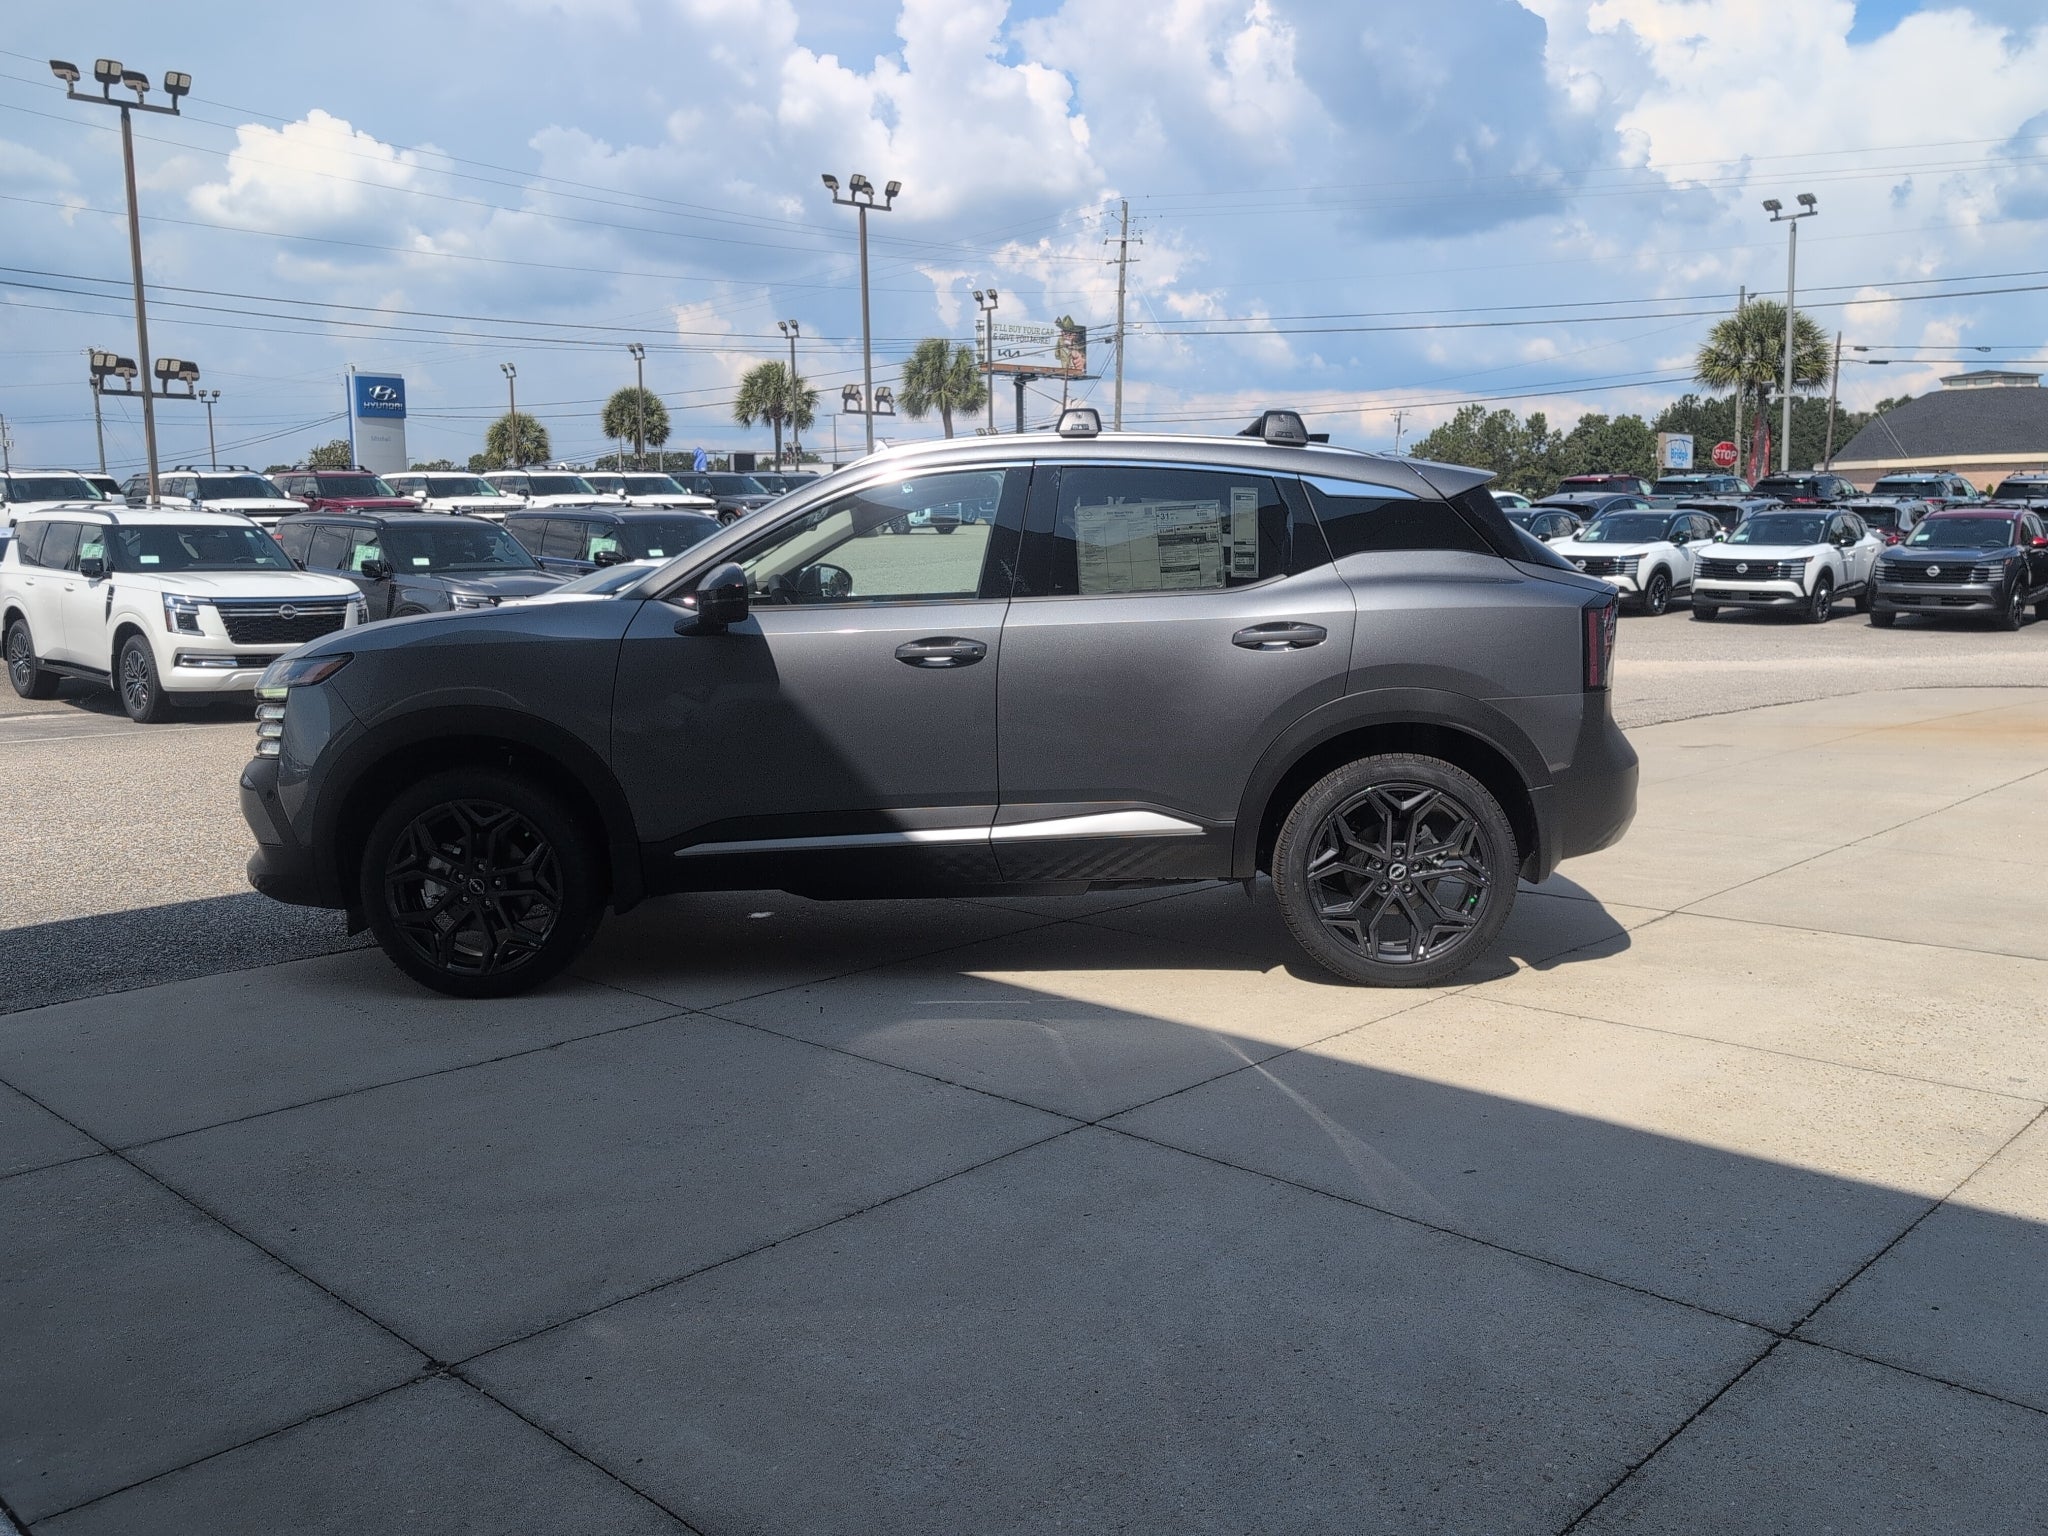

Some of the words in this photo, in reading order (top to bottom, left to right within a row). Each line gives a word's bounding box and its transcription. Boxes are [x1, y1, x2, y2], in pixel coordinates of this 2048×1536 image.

[1008, 324, 1022, 334] BUY
[1023, 326, 1041, 335] YOUR
[1041, 327, 1055, 336] CAR
[363, 401, 403, 411] HYUNDAI
[1671, 447, 1688, 462] Bridge
[1713, 449, 1737, 460] STOP
